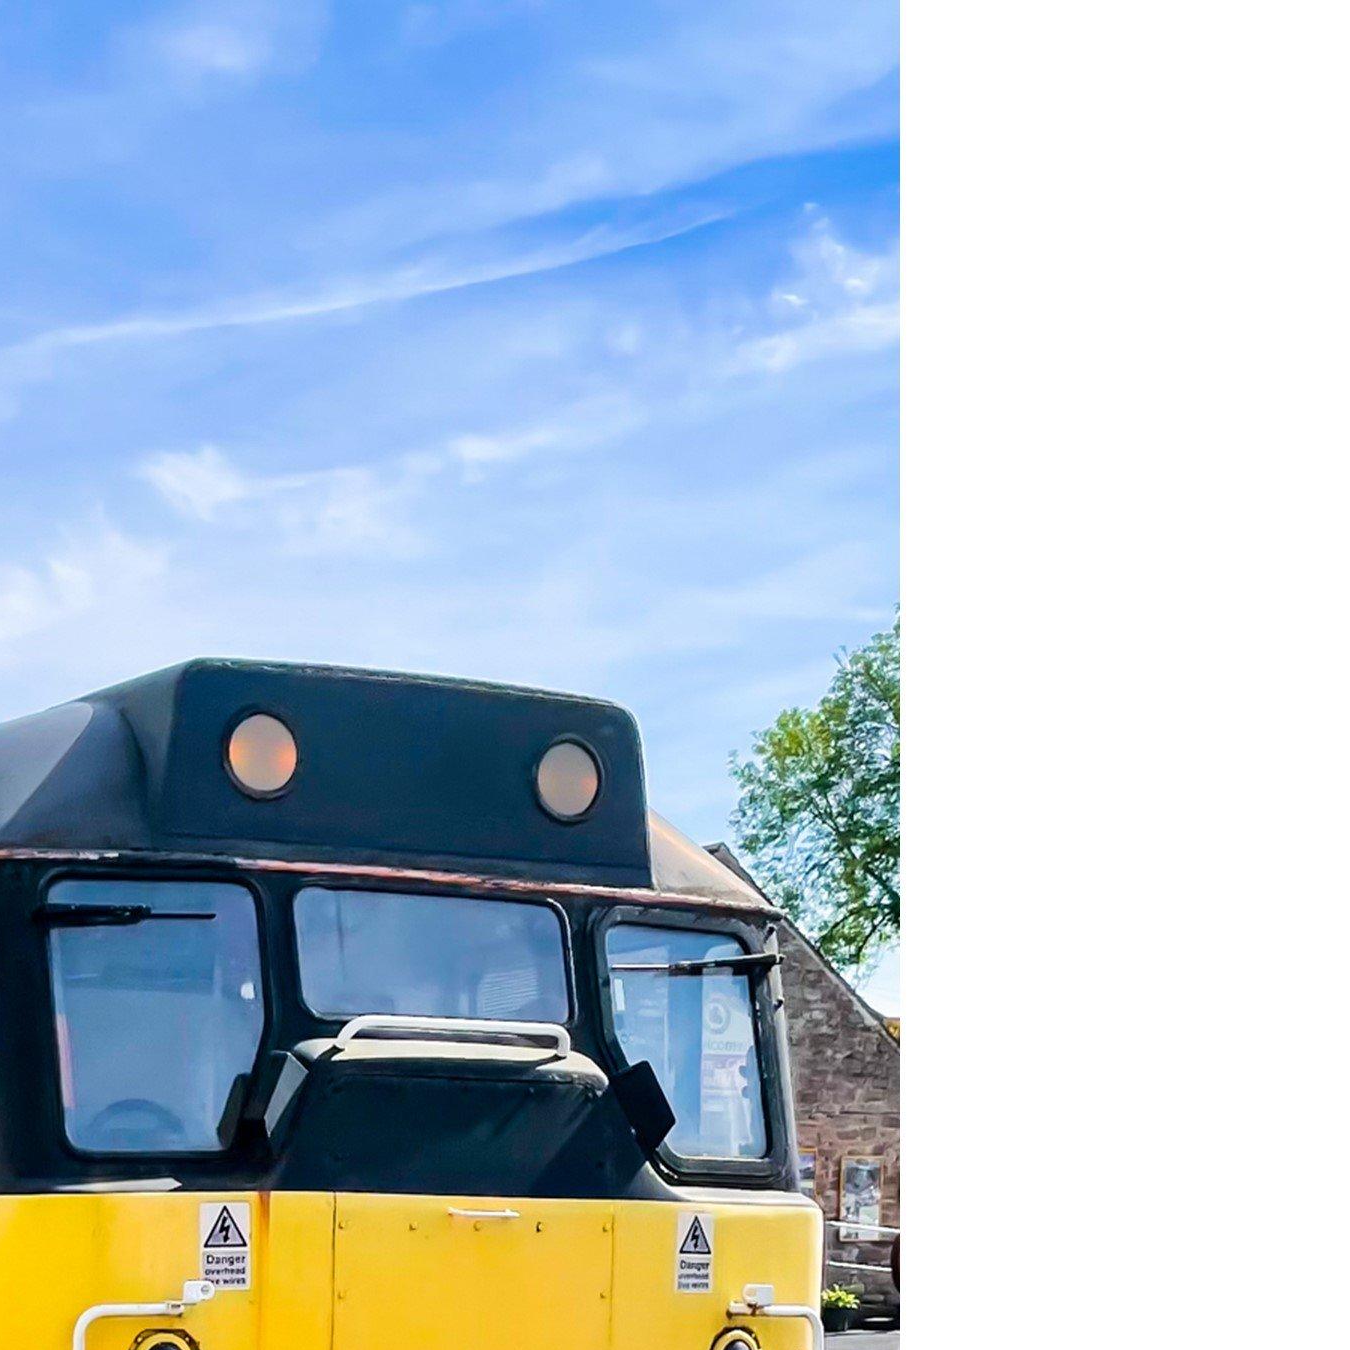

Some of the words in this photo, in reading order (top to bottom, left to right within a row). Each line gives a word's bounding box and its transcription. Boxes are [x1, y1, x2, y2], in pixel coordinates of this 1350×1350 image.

[206, 1255, 245, 1266] Danger
[680, 1260, 709, 1271] Danger
[205, 1267, 245, 1275] overhead
[222, 1277, 246, 1285] wires
